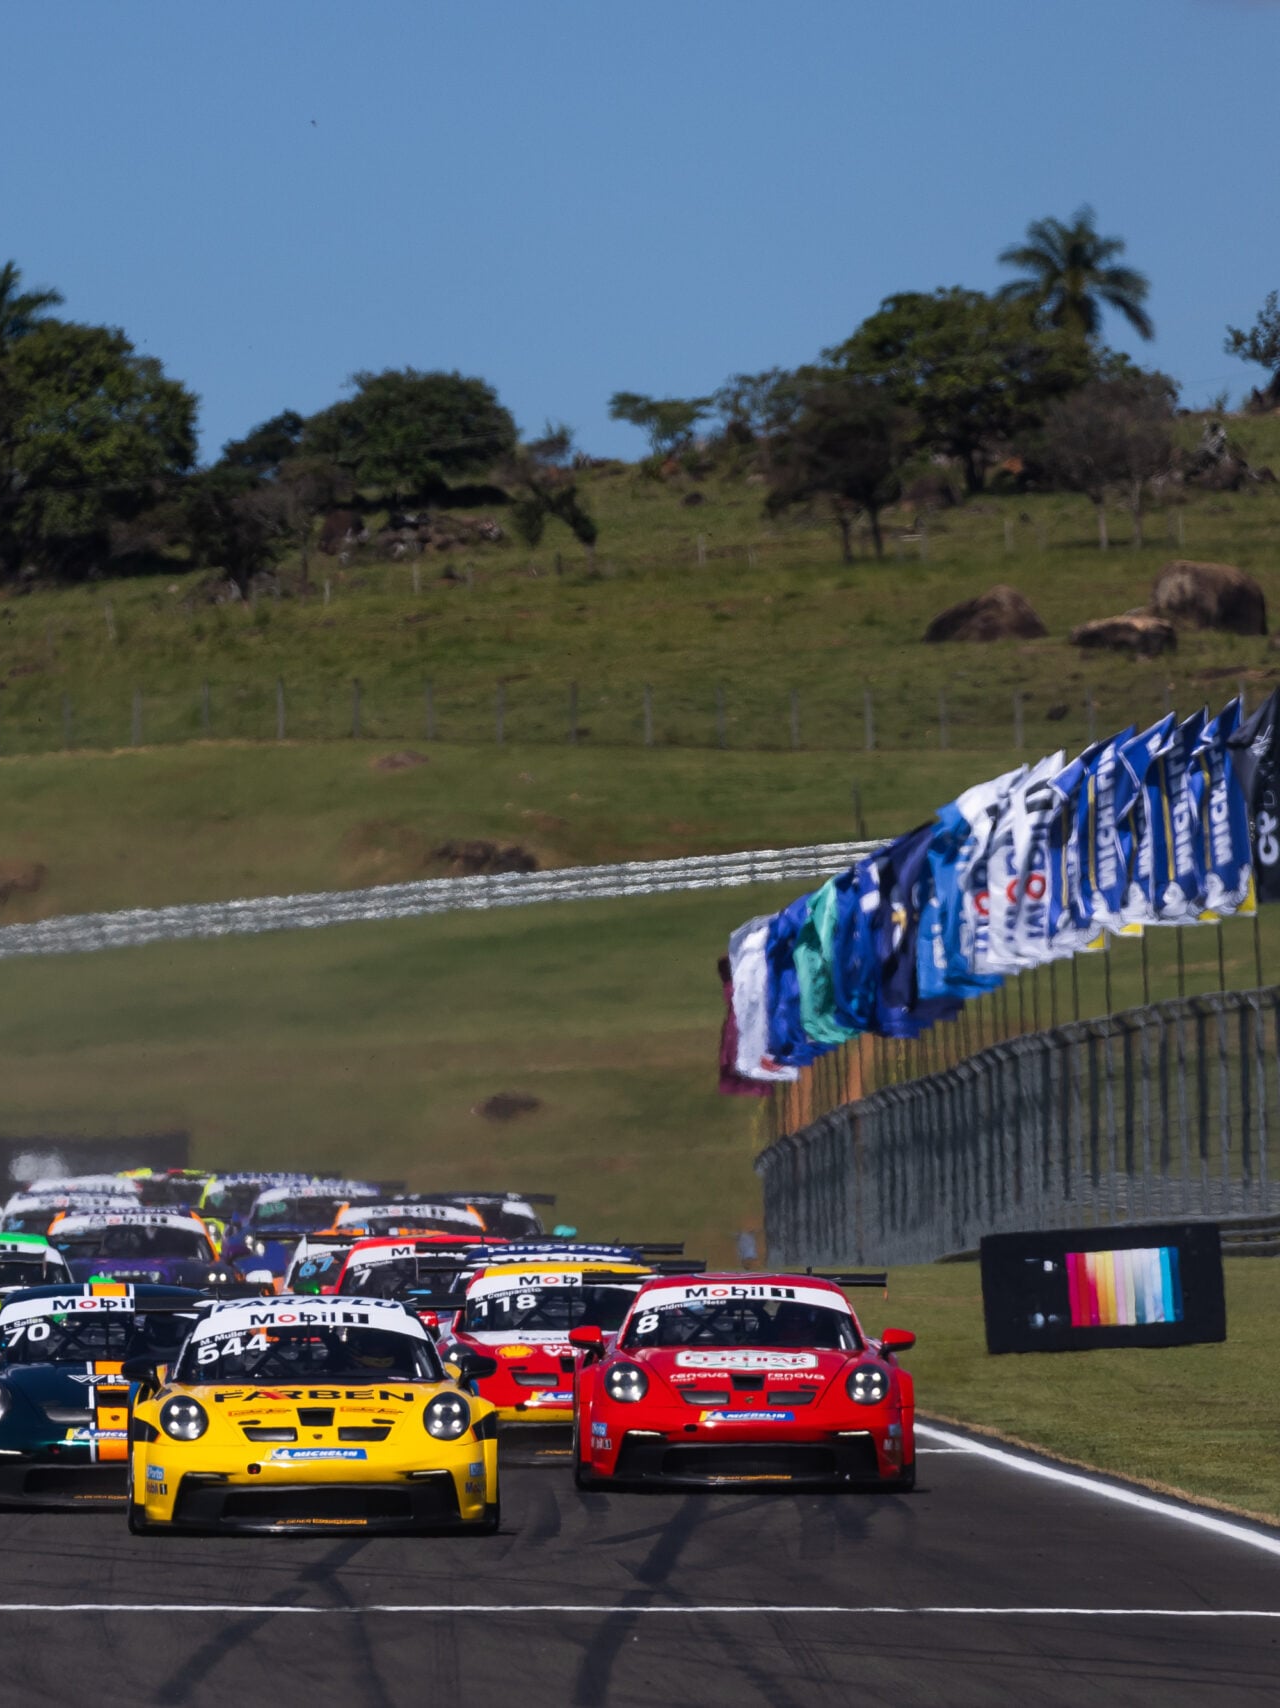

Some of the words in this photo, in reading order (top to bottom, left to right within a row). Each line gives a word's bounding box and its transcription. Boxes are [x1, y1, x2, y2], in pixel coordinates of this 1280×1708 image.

[487, 1244, 623, 1254] Kingspan
[298, 1257, 335, 1278] 67
[353, 1269, 372, 1286] 7
[519, 1275, 579, 1286] Mob
[685, 1286, 765, 1299] Mobil
[53, 1298, 135, 1311] Mobil
[216, 1298, 401, 1312] PARAFLU
[475, 1294, 537, 1317] 118
[250, 1311, 337, 1325] Mobil
[636, 1314, 659, 1335] 8
[4, 1322, 51, 1347] 70
[197, 1333, 271, 1365] 544
[768, 1372, 825, 1380] renova
[214, 1389, 414, 1403] FARBEN
[726, 1412, 786, 1420] MICHELIN
[93, 1430, 128, 1438] MICH
[292, 1450, 359, 1459] MICHELIN
